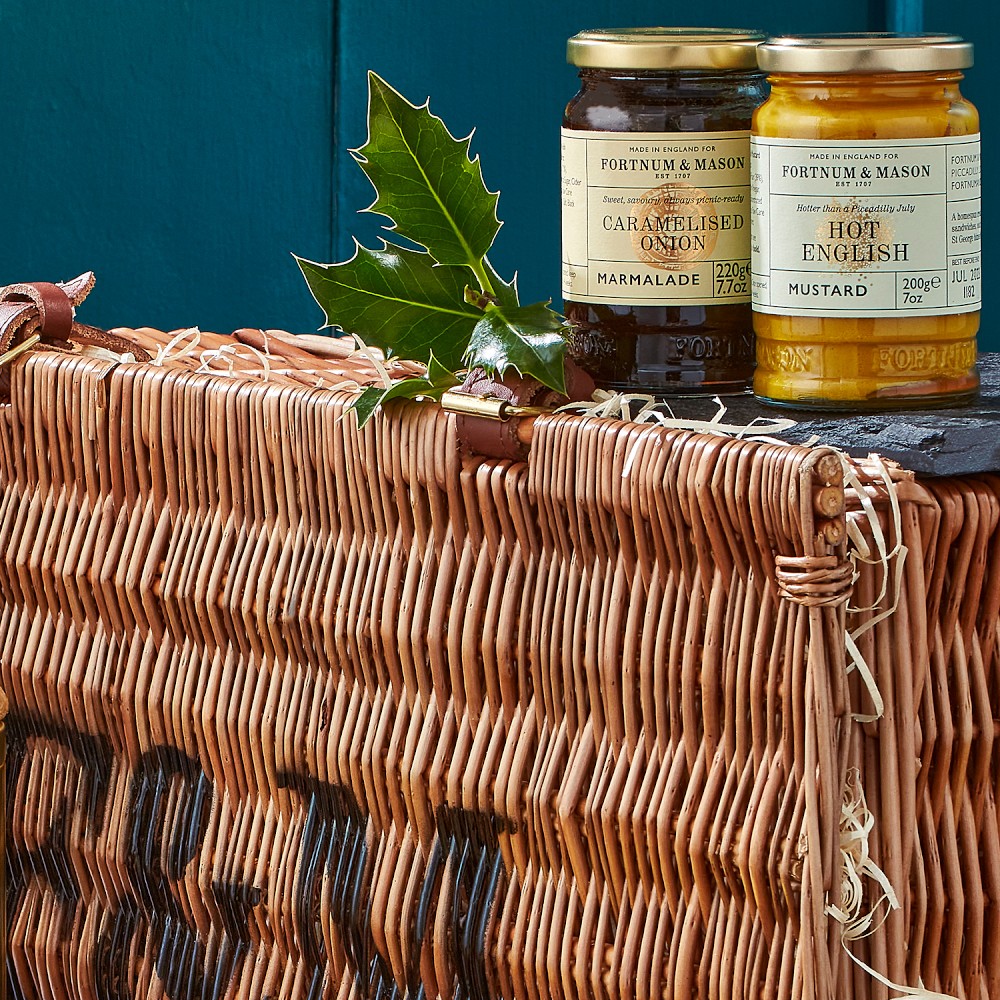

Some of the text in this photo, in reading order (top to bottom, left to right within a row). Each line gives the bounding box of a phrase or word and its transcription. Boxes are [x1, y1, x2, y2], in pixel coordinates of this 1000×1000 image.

[601, 157, 745, 171] FORTNUM & MASON
[782, 165, 931, 179] FORTNUM & MASON
[602, 194, 745, 206] Sweet, savoury, always picnic-ready
[796, 204, 821, 212] Hotter
[822, 204, 842, 213] than
[851, 204, 895, 214] Piccadilly
[896, 204, 916, 213] July
[602, 214, 744, 232] CARAMELISED
[828, 221, 880, 239] HOT
[641, 235, 706, 251] ONION
[801, 243, 909, 262] ENGLISH
[597, 273, 700, 286] MARMALADE
[951, 269, 967, 283] JUL
[716, 279, 747, 295] 7.7oz
[789, 283, 868, 297] MUSTARD
[903, 292, 923, 304] 7oz
